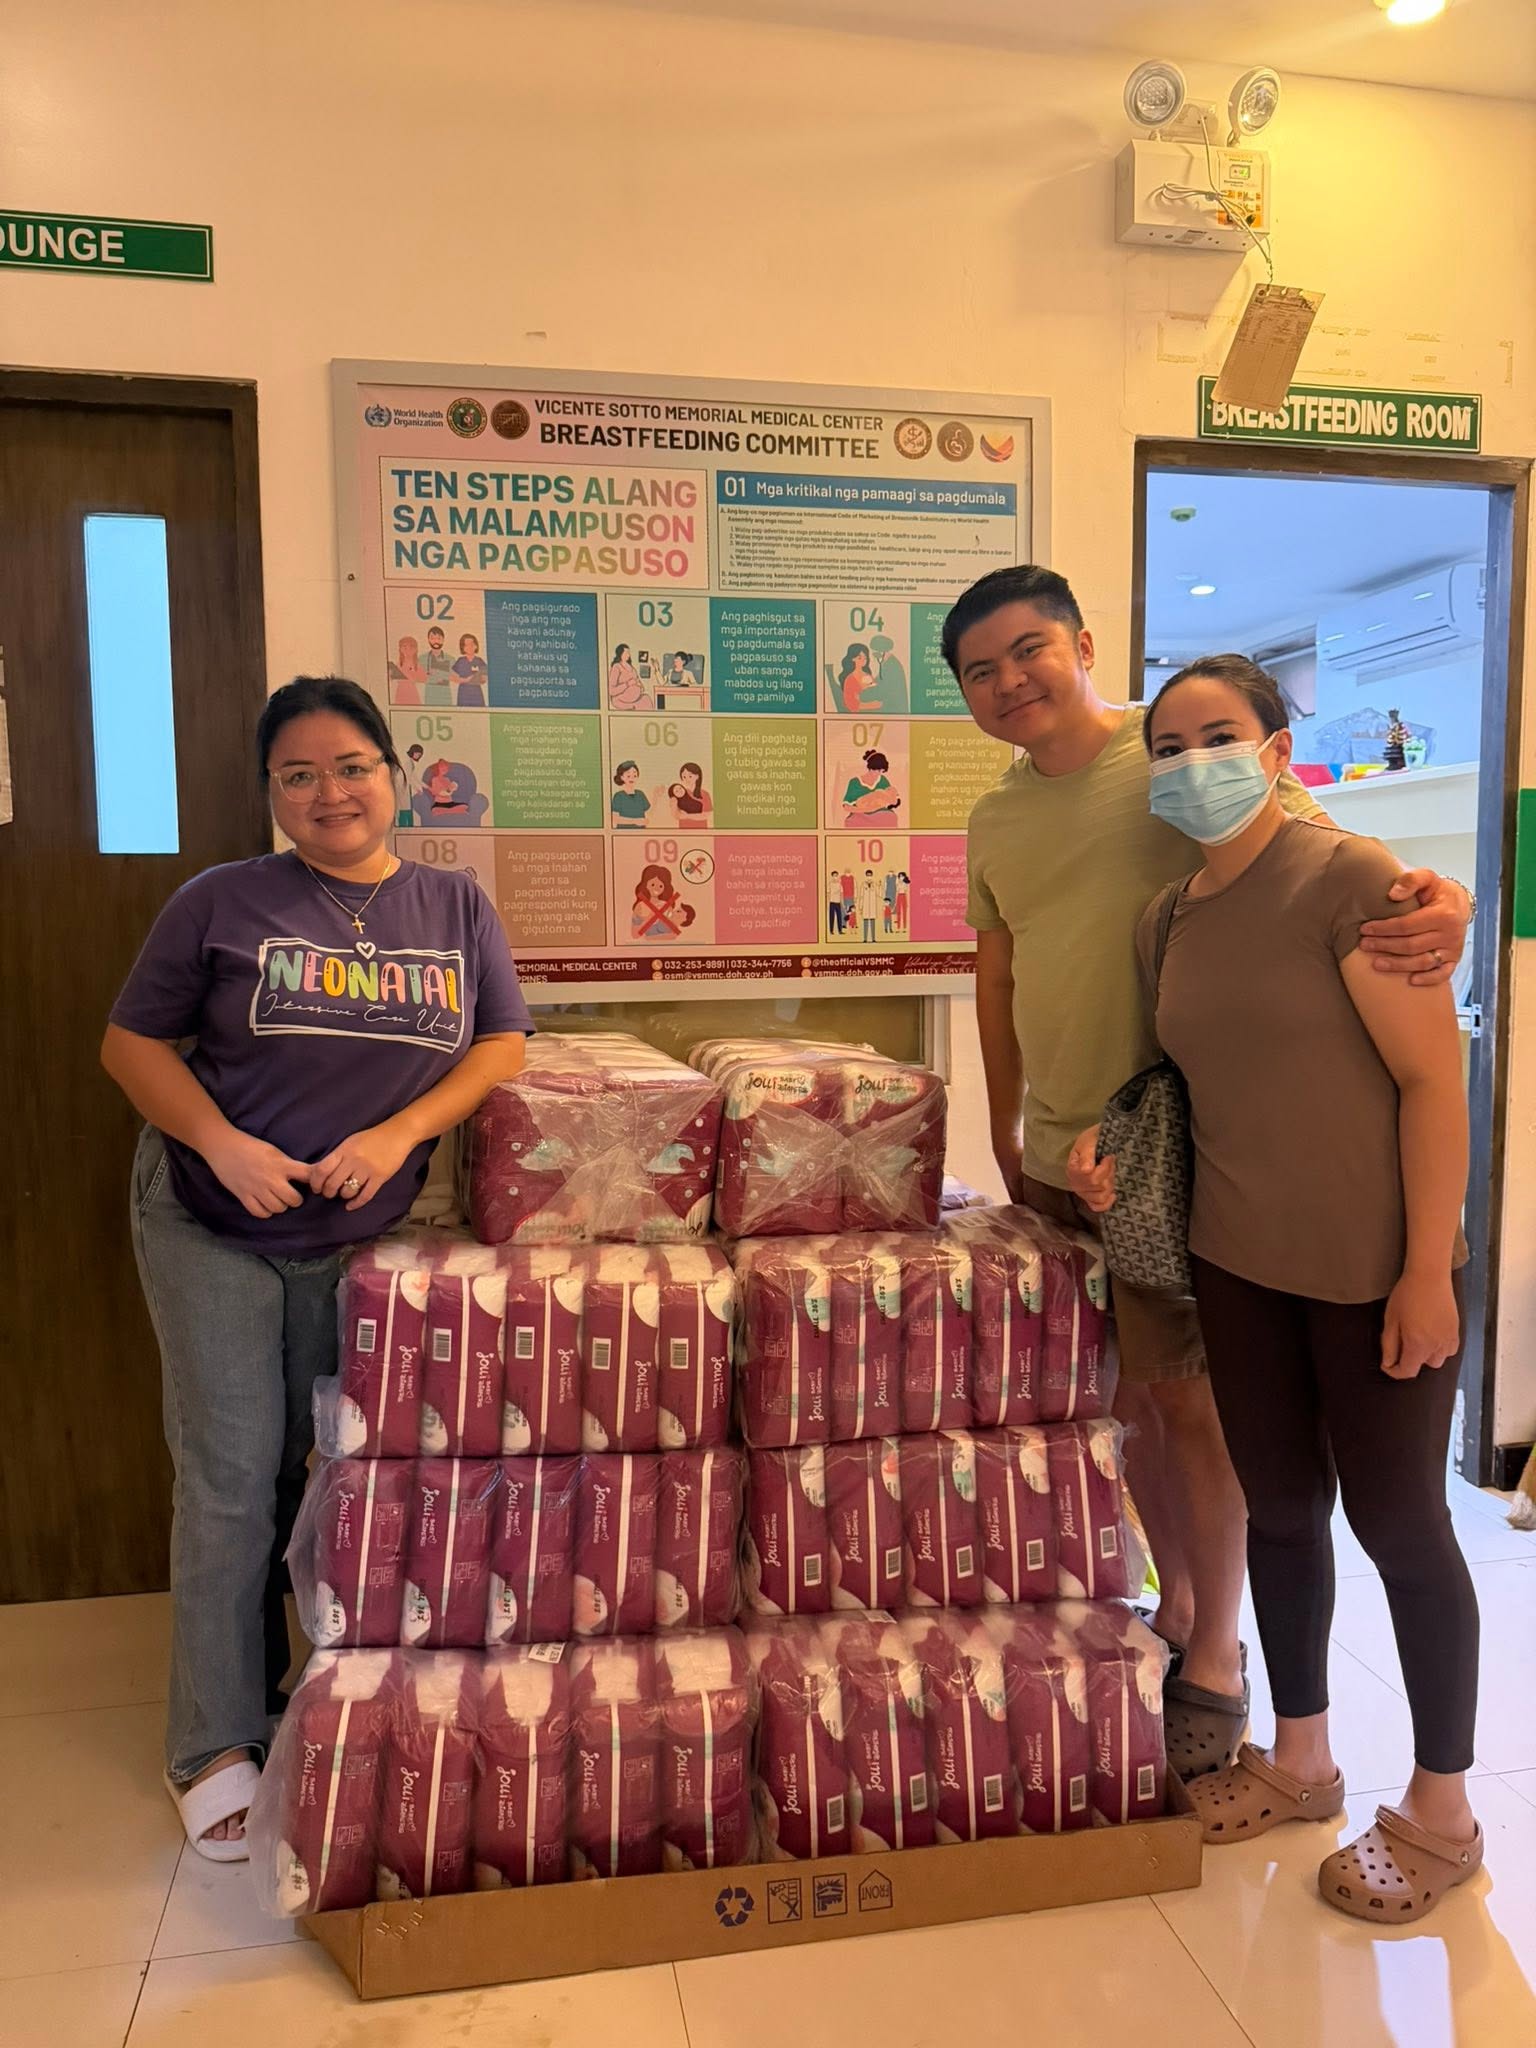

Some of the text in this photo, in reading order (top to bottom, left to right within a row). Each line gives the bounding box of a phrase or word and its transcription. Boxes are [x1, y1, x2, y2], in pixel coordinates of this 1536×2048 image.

[0, 223, 125, 263] UNGE
[393, 409, 443, 419] World Health
[535, 399, 884, 431] VICENTE SOTTO MEMORIAL MEDICAL CENTER
[1211, 395, 1471, 441] BREASTFEEDING ROOM
[393, 417, 443, 428] Organization
[540, 422, 880, 459] BREASTFEEDING COMMITTEE
[391, 469, 697, 508] TEN STEPS ALANG
[724, 477, 1006, 508] 01 Mga kritikal nga pamaagi sa pagdumala
[393, 504, 440, 534] SA
[449, 507, 694, 542] MALAMPUSON
[395, 540, 688, 577] NGA PAGPASUSO
[416, 594, 455, 620] 02
[502, 602, 580, 614] Ang pagsigurado
[639, 601, 673, 627] 03
[721, 611, 805, 624] Ang paghisgut sa
[850, 607, 884, 632] 04
[512, 616, 571, 625] nga ang mga
[507, 627, 576, 638] kawani adunay
[721, 625, 805, 637] mga importansya
[507, 639, 534, 650] igong
[723, 639, 804, 650] ug pagdumala sa
[517, 652, 568, 663] katakus ug
[731, 653, 797, 664] pagpasuso sa
[517, 664, 556, 673] kahanas
[735, 666, 759, 675] uban
[511, 677, 563, 686] pagsuporta
[725, 679, 803, 691] mabdos ug ilang
[519, 689, 570, 699] pagpasuso
[734, 692, 795, 704] mga pamilya
[416, 716, 453, 741] 05
[644, 722, 679, 746] 06
[723, 733, 743, 744] Ang
[762, 734, 807, 745] paghatag
[852, 723, 884, 747] 07
[929, 736, 946, 746] Ang
[725, 748, 737, 757] ug
[765, 747, 806, 757] pagkaon
[734, 758, 759, 769] tubig
[762, 760, 792, 770] gawas
[727, 771, 754, 780] gatas
[741, 783, 792, 793] gawas kon
[778, 795, 795, 804] nga
[421, 839, 457, 865] 08
[508, 850, 591, 863] Ang pagsuporta
[644, 839, 678, 863] 09
[857, 839, 883, 863] 10
[728, 854, 803, 865] Ang pagtambag
[512, 863, 587, 874] sa mga inahan
[745, 868, 765, 877] mga
[531, 877, 569, 885] aron sa
[755, 881, 766, 889] sa
[515, 888, 577, 899] pagmatikod
[784, 895, 795, 904] ug
[504, 900, 597, 911] pagrespondi kung
[513, 912, 590, 923] ang iyang anak
[522, 924, 565, 936] gigutom
[741, 919, 791, 930] ug pacifier
[515, 962, 638, 972] MEMORIAL MEDICAL CENTER
[269, 950, 461, 1012] NEONATAL
[416, 1009, 459, 1034] Unit
[862, 1884, 889, 1901] FRONT
